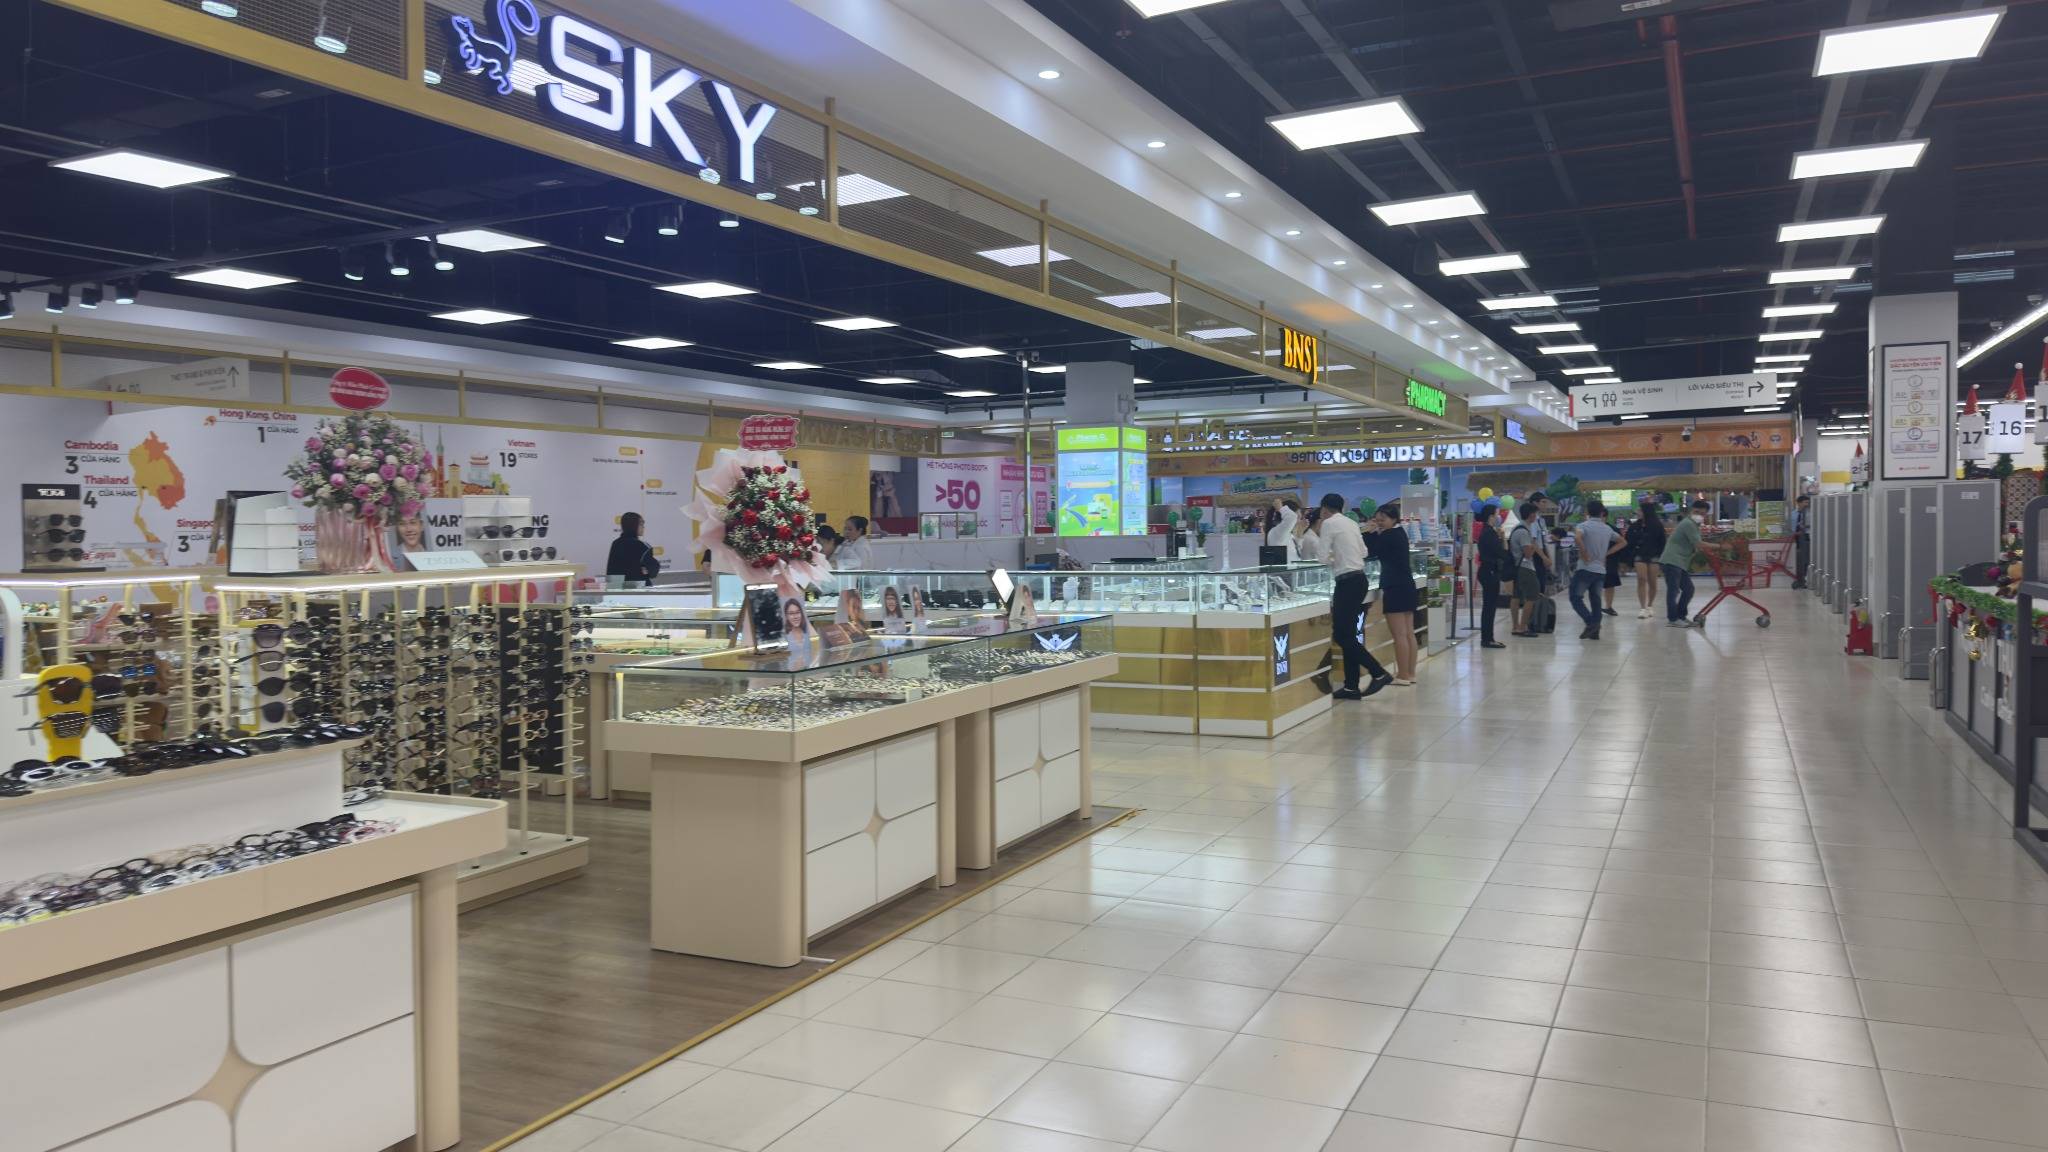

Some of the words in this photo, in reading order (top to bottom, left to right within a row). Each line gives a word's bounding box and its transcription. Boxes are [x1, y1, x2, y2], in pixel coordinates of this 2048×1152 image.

[546, 14, 779, 184] SKY
[1284, 327, 1319, 385] BNSJ
[1407, 378, 1447, 416] PHARMACY
[219, 408, 243, 419] Hong
[272, 412, 296, 421] China
[257, 427, 265, 443] 1
[2000, 421, 2022, 436] 16
[64, 440, 119, 450] Cambodia
[508, 440, 536, 448] Vietnam
[1962, 431, 1982, 444] 17
[1431, 442, 1495, 460] FARM
[65, 456, 79, 474] 3
[499, 452, 517, 467] 19
[84, 475, 128, 484] Thailand
[83, 491, 97, 508] 4
[177, 536, 190, 552] 3
[435, 534, 462, 547] OH!
